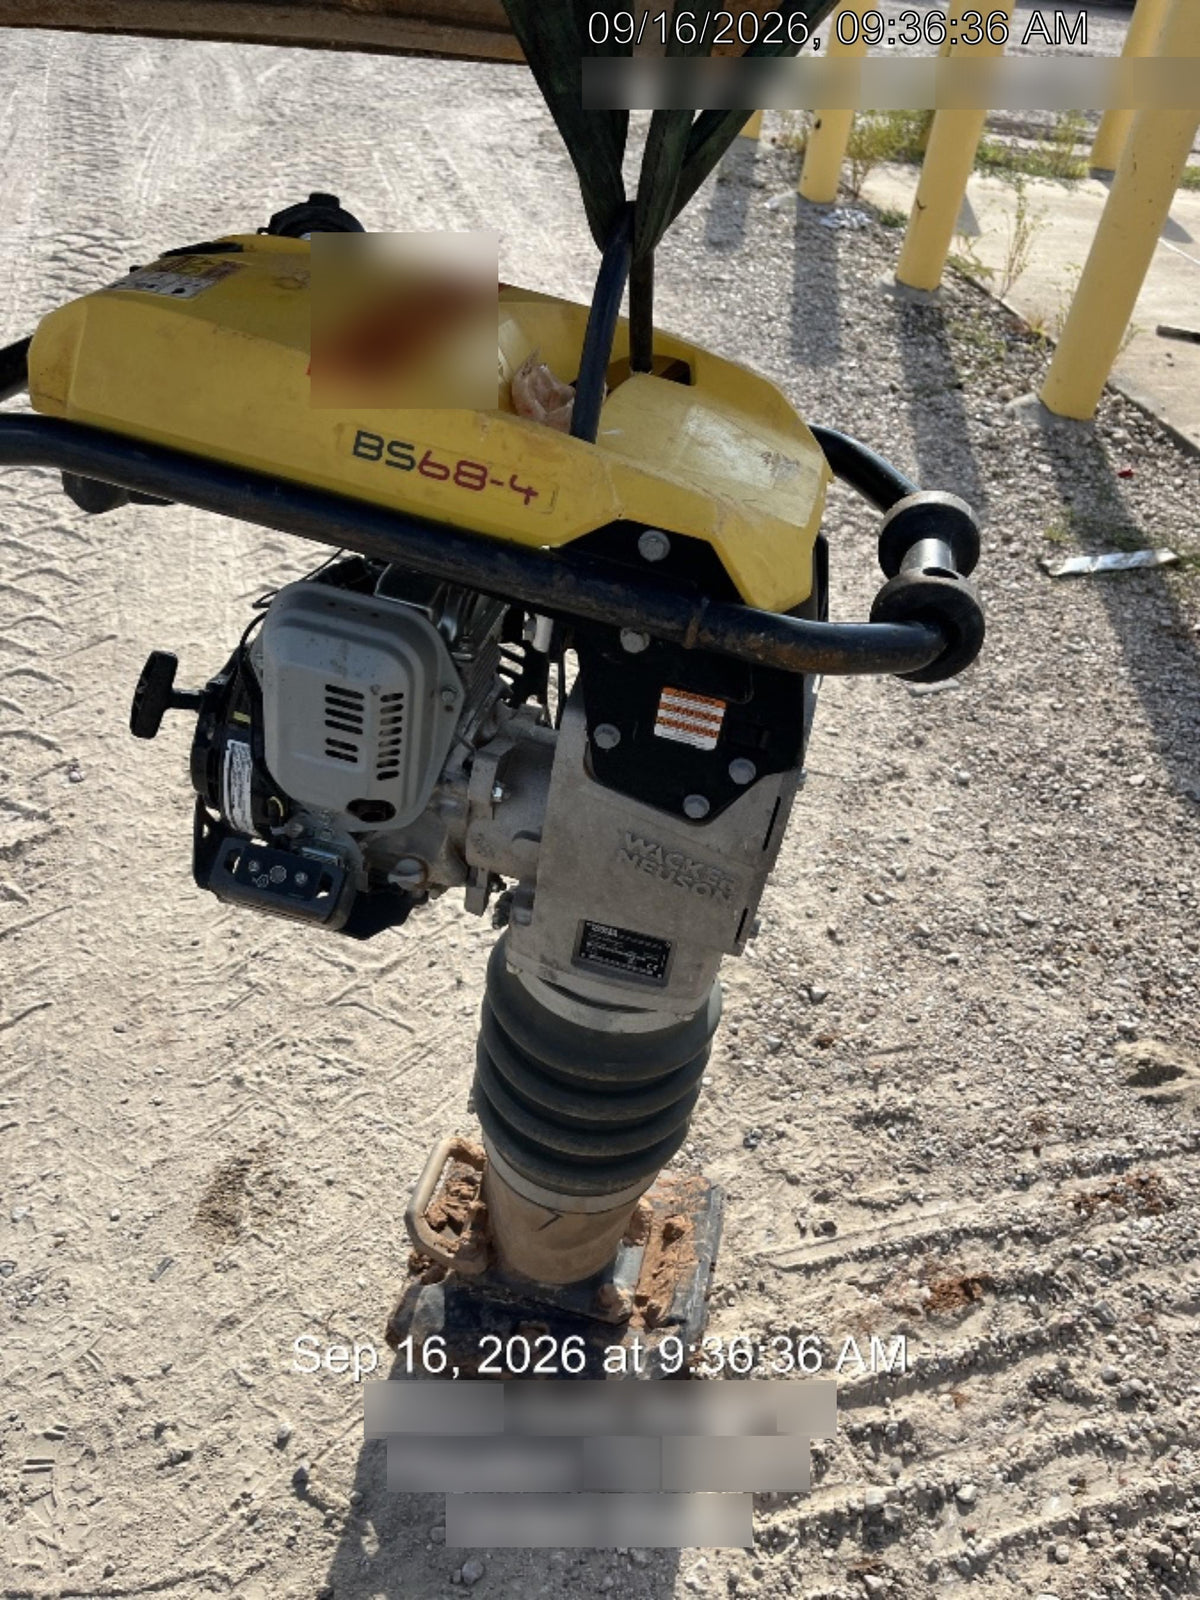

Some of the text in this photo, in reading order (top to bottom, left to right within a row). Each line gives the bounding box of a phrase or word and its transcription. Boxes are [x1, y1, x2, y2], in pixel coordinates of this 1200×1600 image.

[353, 430, 539, 505] BS68-4
[617, 846, 733, 904] NEUSON
[624, 830, 736, 896] WACKER
